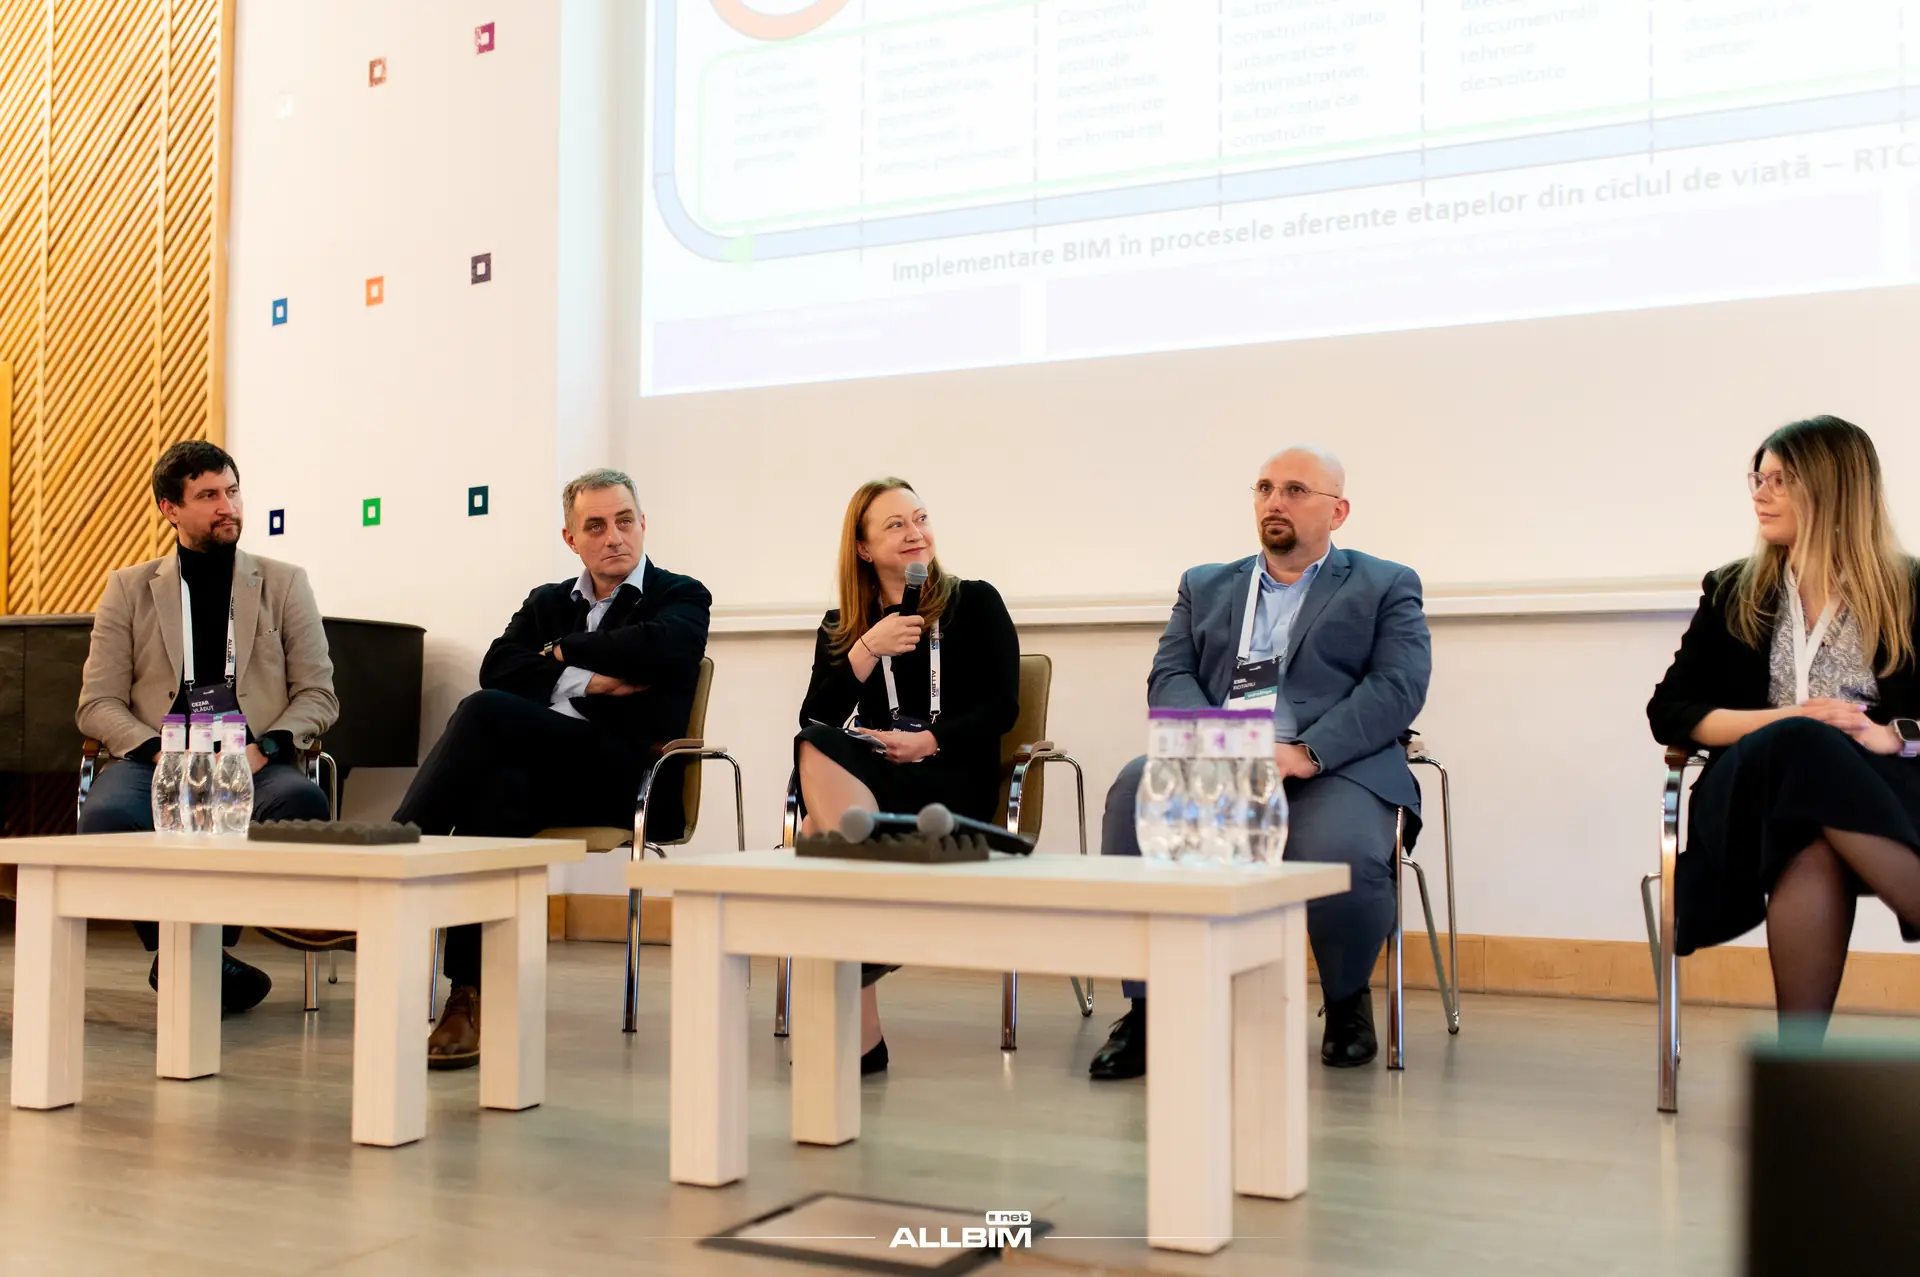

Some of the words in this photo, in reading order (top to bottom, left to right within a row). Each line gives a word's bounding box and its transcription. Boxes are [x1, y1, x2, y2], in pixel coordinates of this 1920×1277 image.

[893, 245, 1054, 281] Implementare
[1064, 238, 1111, 263] BIM
[1119, 235, 1142, 257] în
[1151, 220, 1272, 257] procesele
[1283, 207, 1398, 238] aferente
[1407, 190, 1526, 225] etapelor
[1538, 183, 1585, 209] din
[1595, 170, 1672, 203] ciclul
[1683, 167, 1722, 192] de
[1732, 154, 1811, 187] viață
[191, 700, 210, 708] CEZAR
